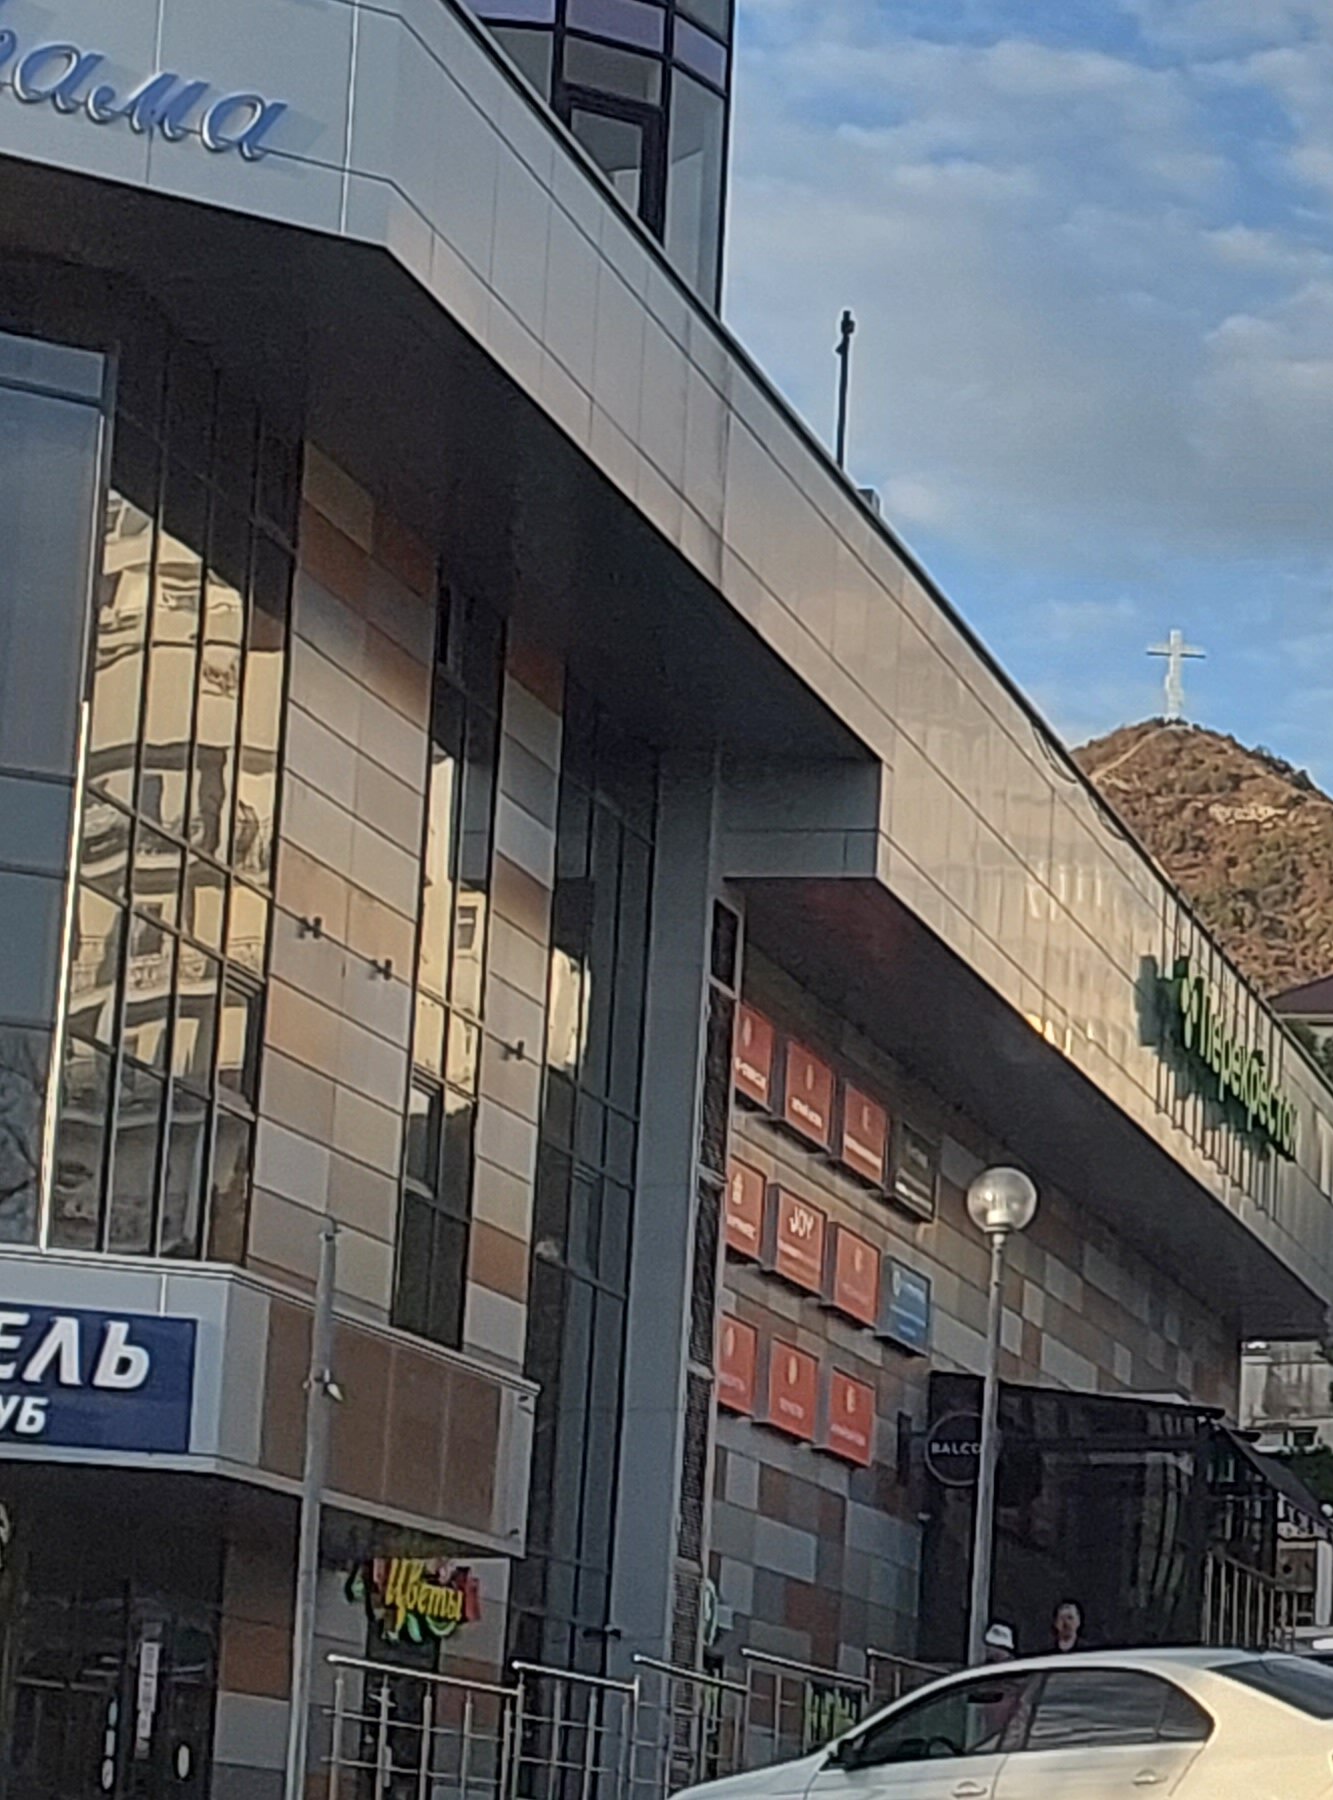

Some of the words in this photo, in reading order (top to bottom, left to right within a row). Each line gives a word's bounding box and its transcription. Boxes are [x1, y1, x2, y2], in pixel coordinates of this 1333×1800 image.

[0, 29, 287, 161] ама
[789, 1205, 814, 1240] JOY
[385, 1558, 463, 1633] Цветы
